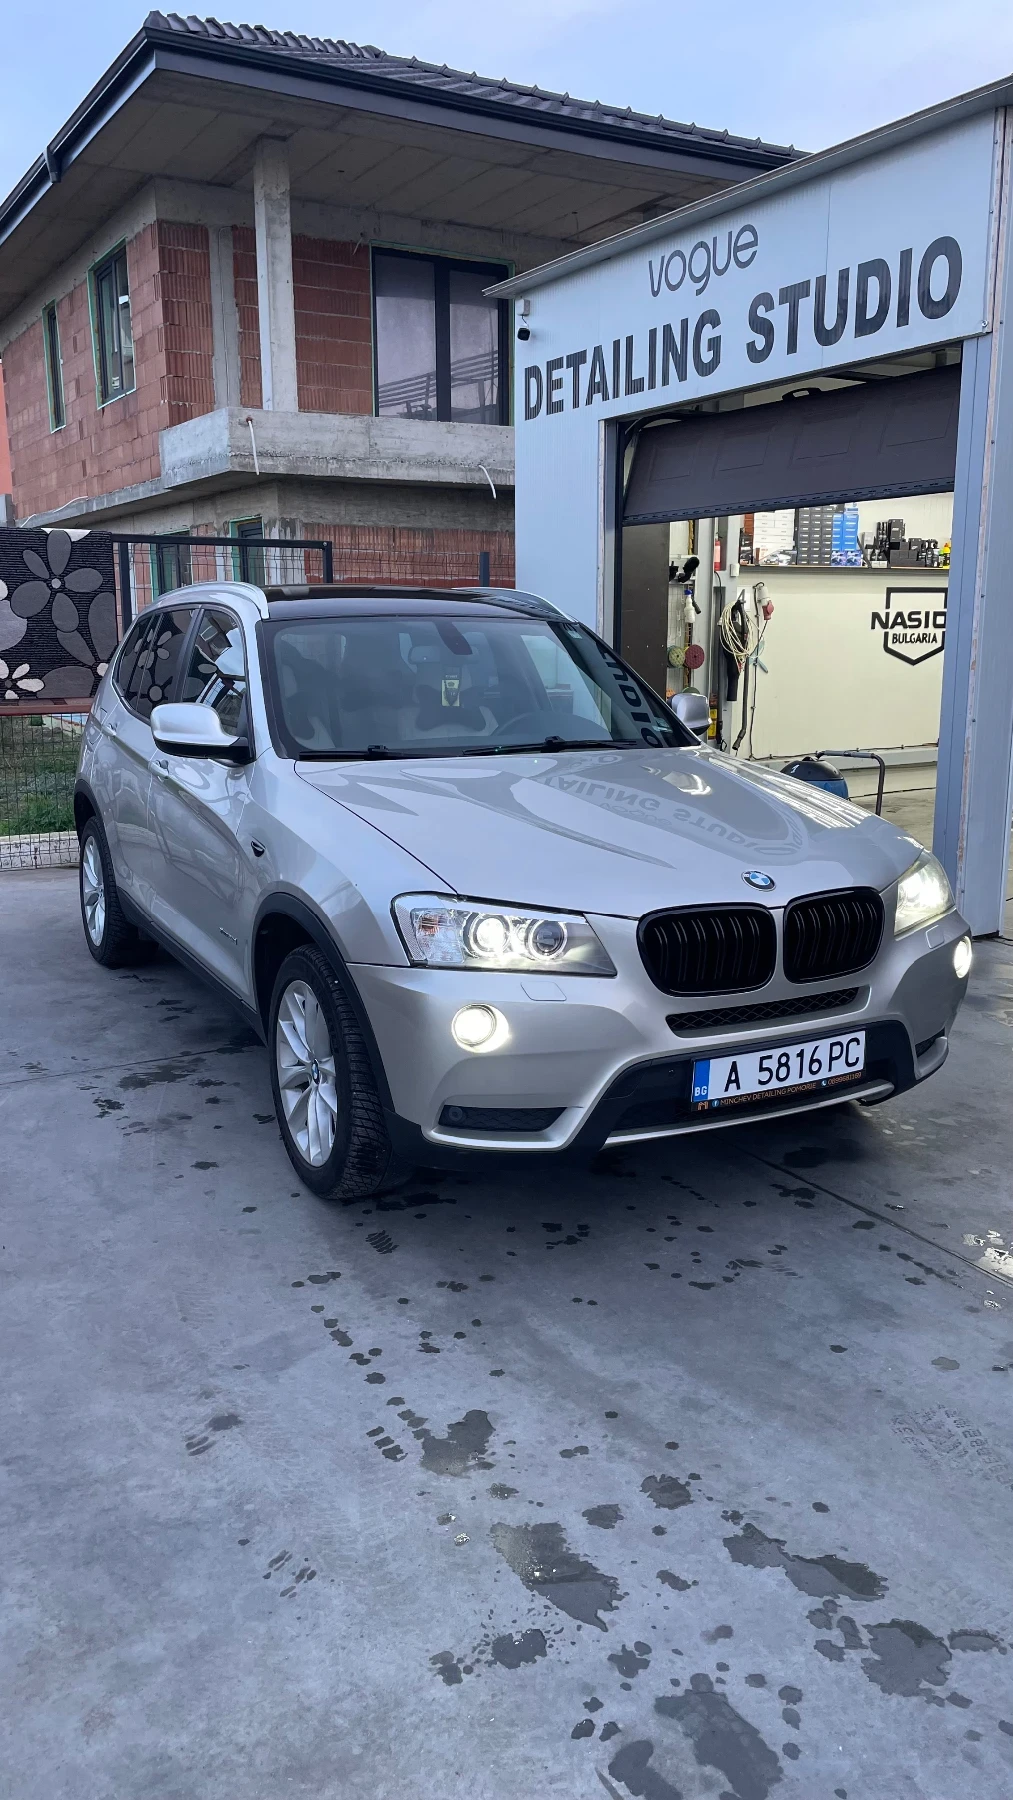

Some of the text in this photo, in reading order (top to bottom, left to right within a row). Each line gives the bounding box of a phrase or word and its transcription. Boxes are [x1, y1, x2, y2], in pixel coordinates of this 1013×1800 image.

[648, 223, 759, 297] vogue
[524, 235, 963, 421] DETAILING STUDIO
[891, 632, 938, 644] BULGARIA
[724, 1060, 741, 1092] A
[694, 1086, 708, 1097] BG
[720, 1094, 752, 1106] MINCHEV
[752, 1087, 787, 1100] DETAILING
[787, 1082, 817, 1094] POMORIE
